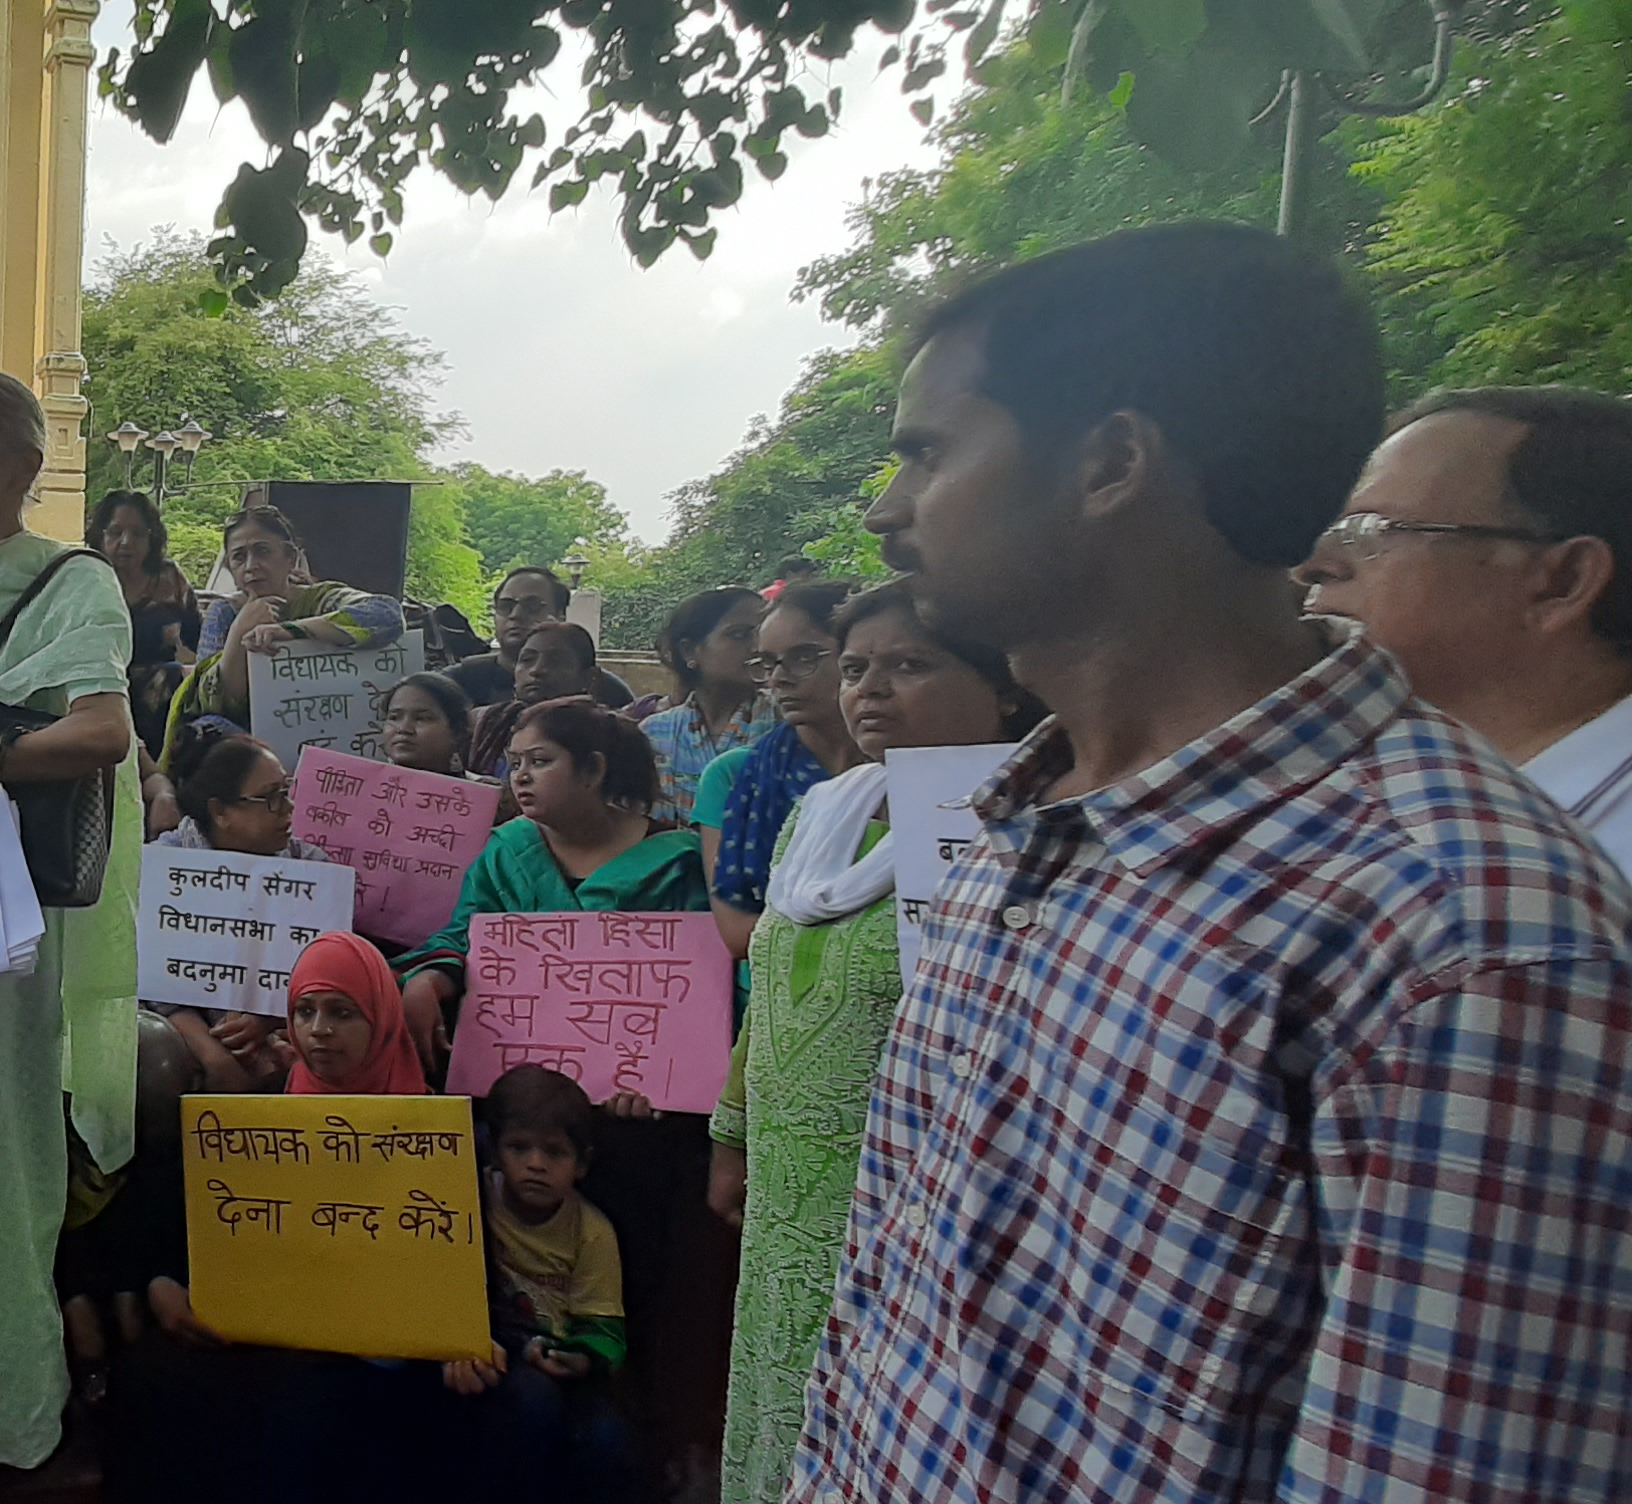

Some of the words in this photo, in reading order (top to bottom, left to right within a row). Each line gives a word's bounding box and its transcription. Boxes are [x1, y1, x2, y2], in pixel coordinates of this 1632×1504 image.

[271, 646, 359, 682] विधायक
[374, 641, 409, 674] को
[273, 689, 354, 728] संरक्षण
[416, 787, 474, 817] उसके
[368, 808, 394, 837] को
[168, 865, 251, 897] कुलदीप
[262, 871, 317, 901] सेंगर
[414, 859, 460, 880] प्रदान
[158, 904, 276, 942] विधानसभा
[167, 957, 247, 992] बदनुमा
[479, 947, 516, 987] के
[476, 993, 540, 1038] हम
[566, 1000, 668, 1045] सब
[190, 1110, 309, 1165] विधायक
[316, 1116, 371, 1164] को
[371, 1125, 464, 1162] संरक्षण
[207, 1179, 292, 1236] देना
[311, 1202, 385, 1240] बन्द
